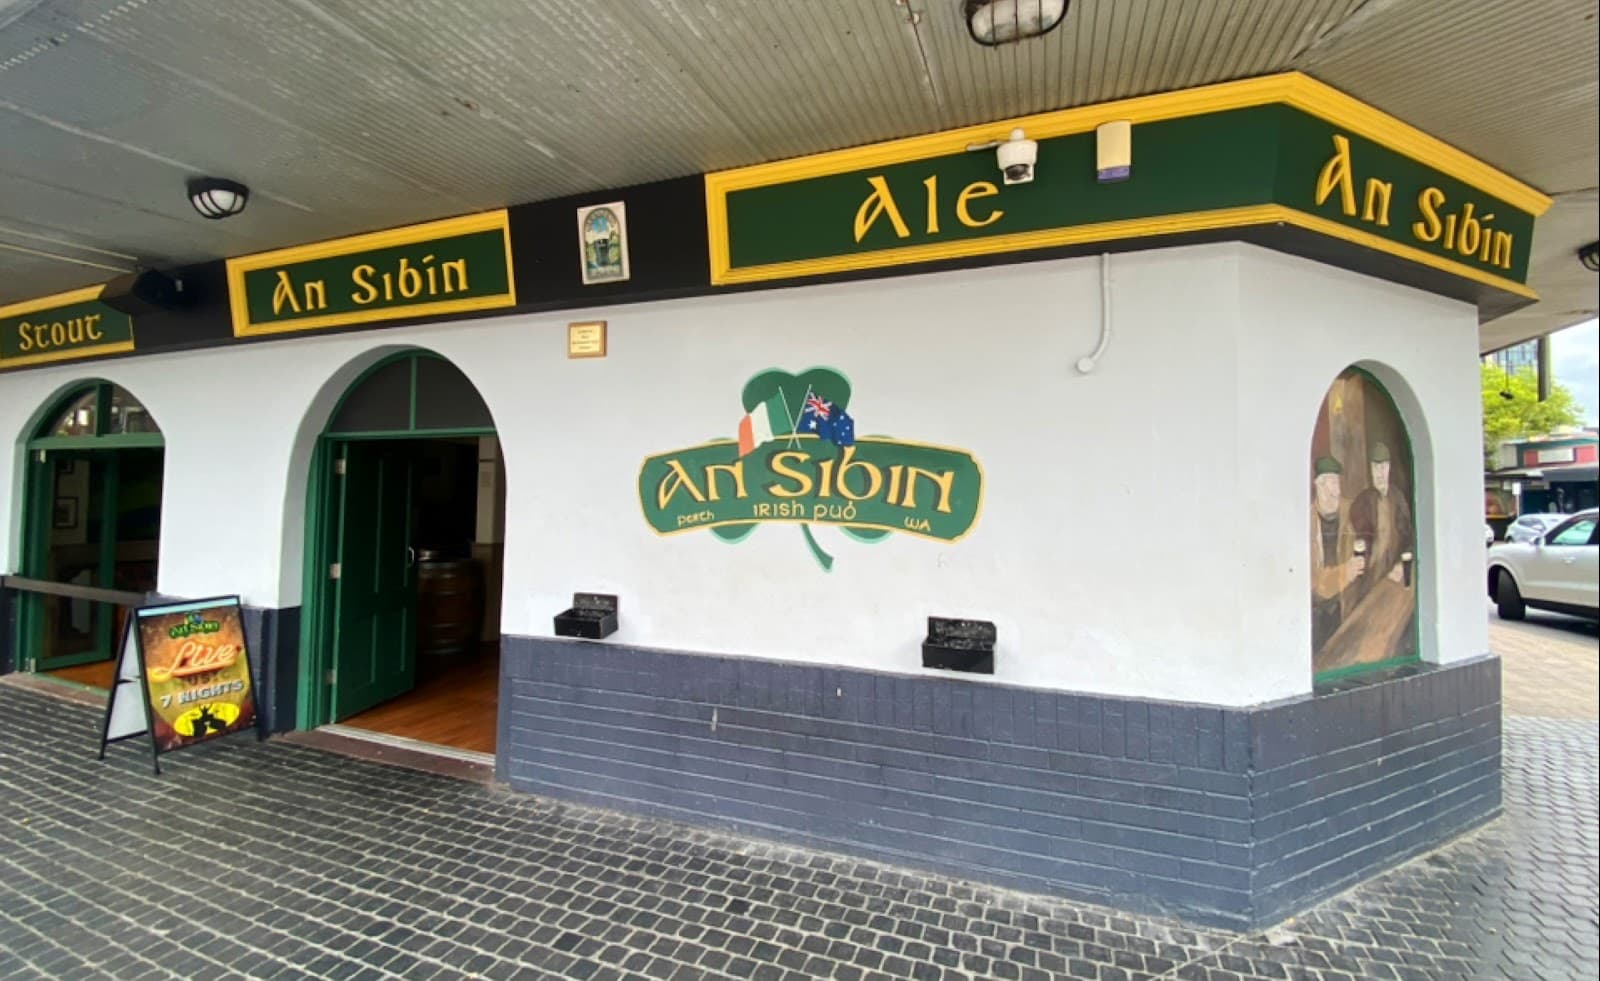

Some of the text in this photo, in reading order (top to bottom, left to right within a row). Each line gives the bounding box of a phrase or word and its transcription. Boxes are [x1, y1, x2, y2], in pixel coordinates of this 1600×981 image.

[1315, 134, 1393, 226] An
[854, 175, 1004, 244] Ale
[272, 270, 328, 316] An
[18, 313, 104, 351] Stout
[151, 639, 234, 680] Live
[161, 680, 244, 708] 7 NIGHTS
